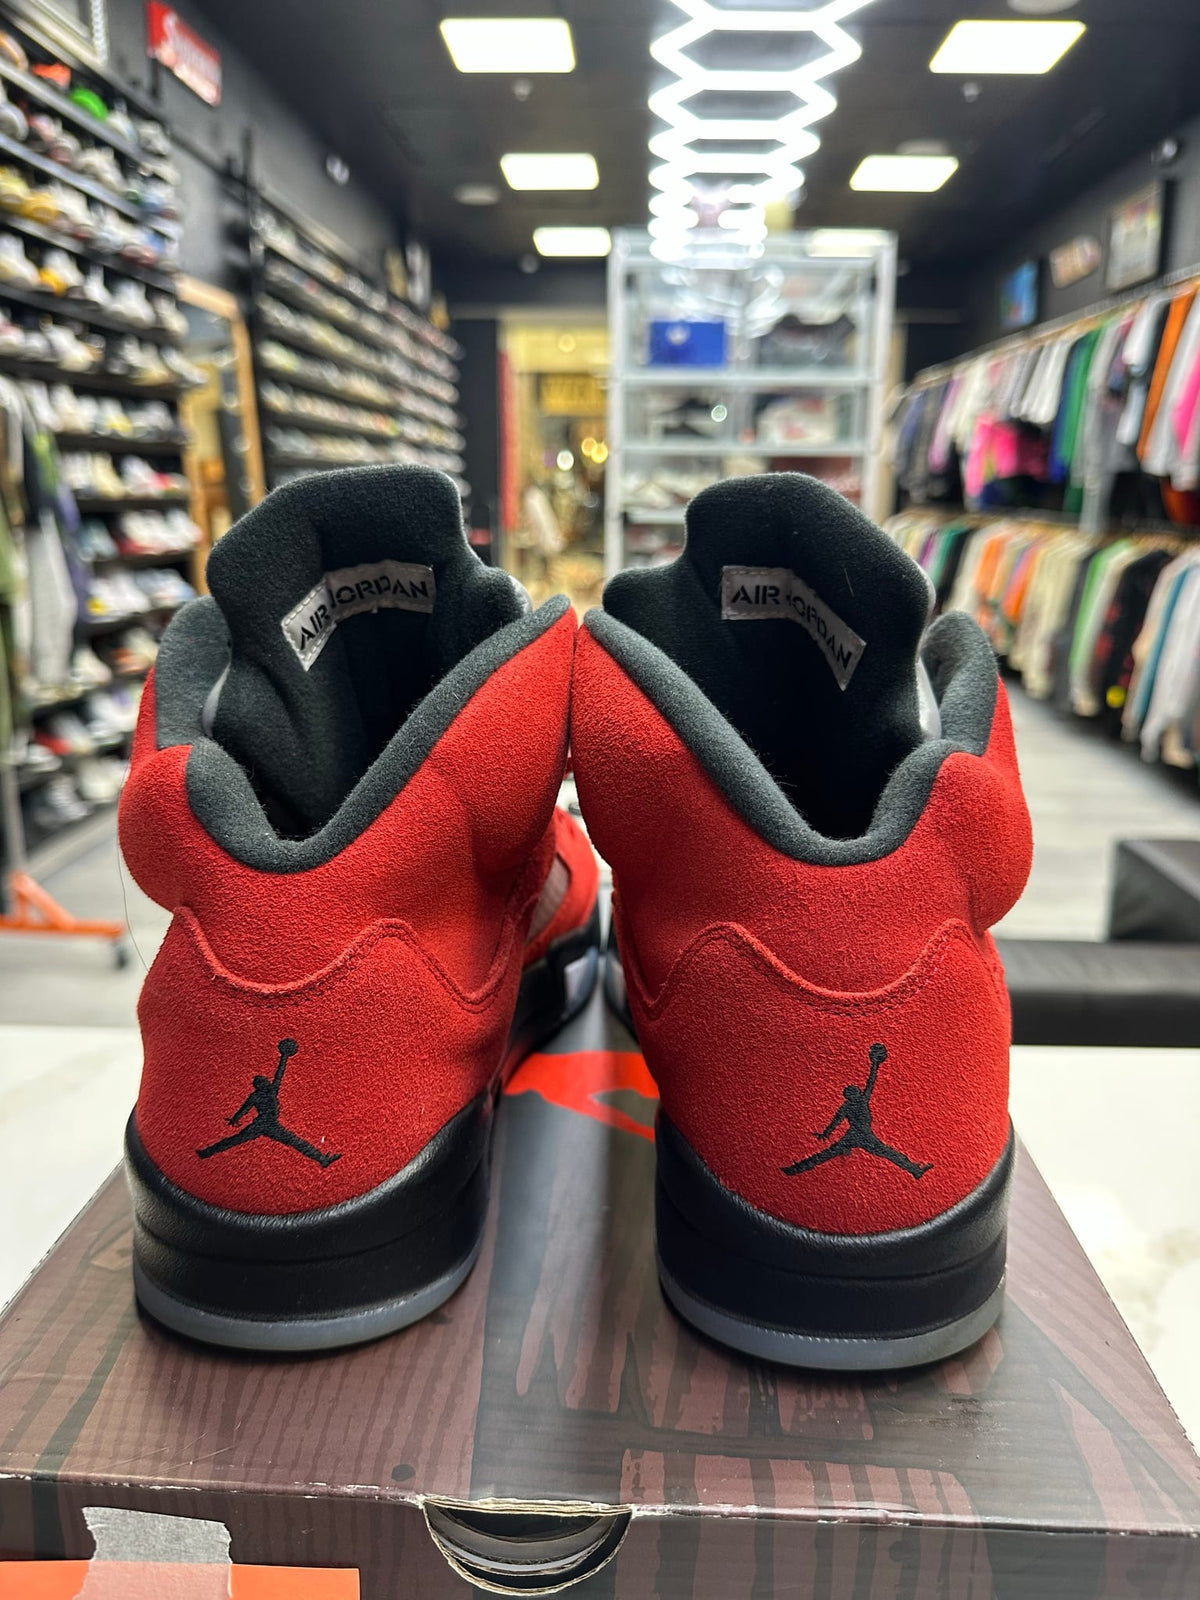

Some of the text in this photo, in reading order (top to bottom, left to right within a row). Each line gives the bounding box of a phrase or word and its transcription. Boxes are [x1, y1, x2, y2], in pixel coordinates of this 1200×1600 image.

[300, 575, 429, 650] AIR JORDAN
[731, 585, 781, 605] AIR
